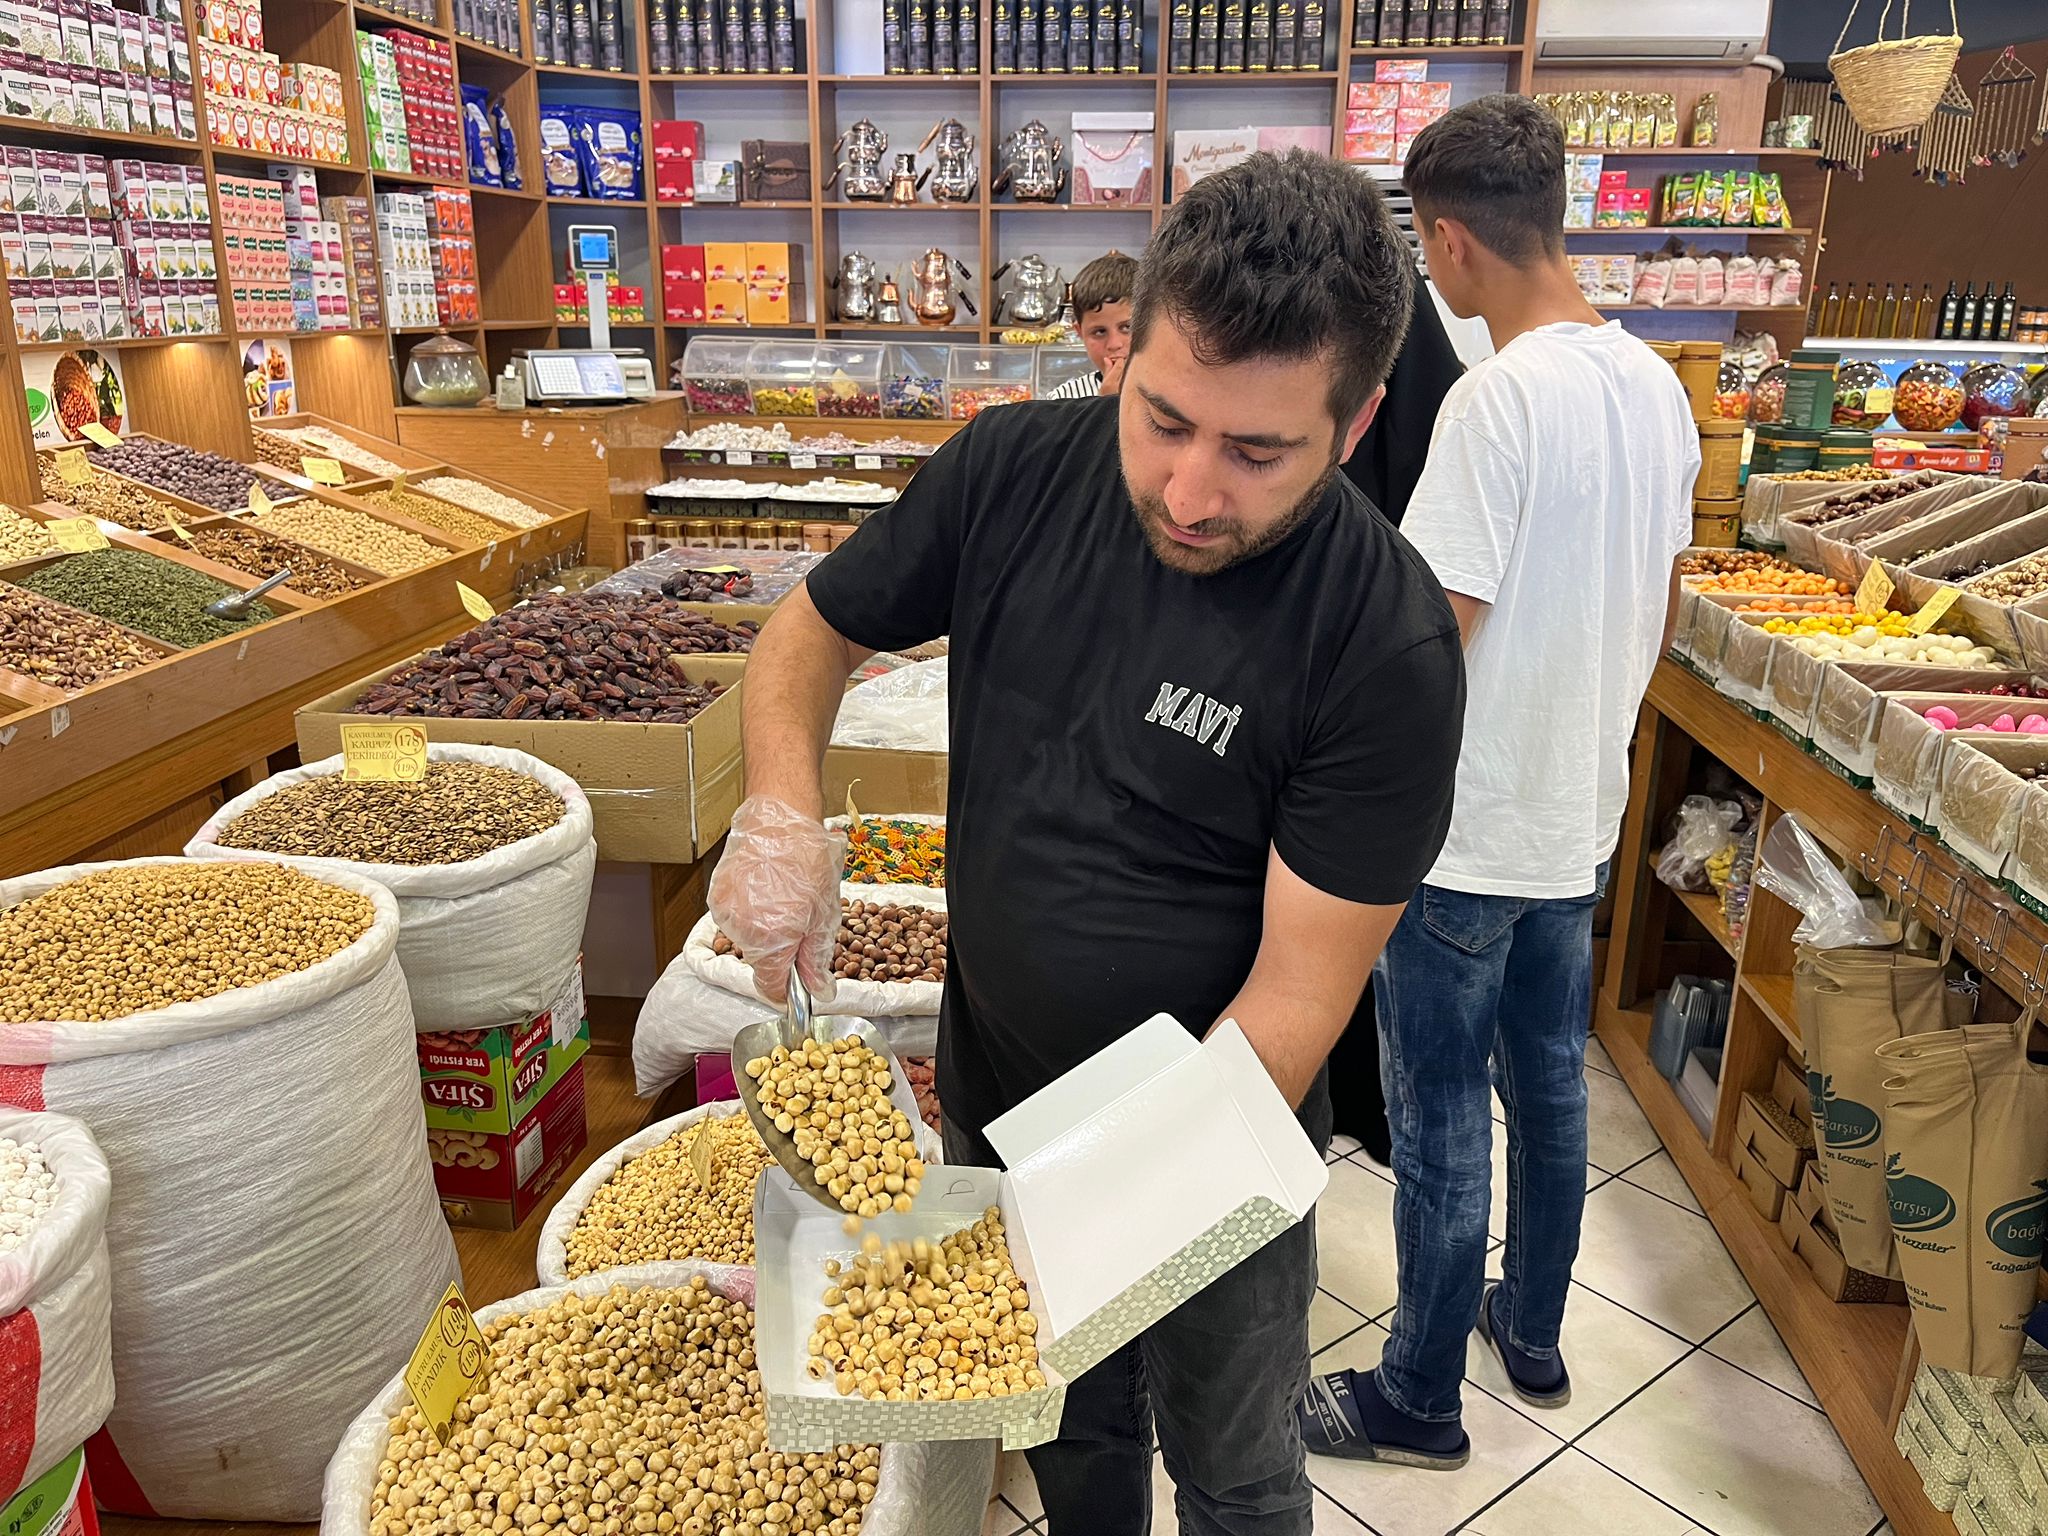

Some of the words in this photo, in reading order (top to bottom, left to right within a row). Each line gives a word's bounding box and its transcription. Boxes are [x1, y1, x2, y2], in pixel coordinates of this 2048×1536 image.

[352, 740, 392, 749] KARPUZ
[429, 1055, 463, 1066] FISTIĞI
[466, 1057, 485, 1068] YER
[429, 1083, 485, 1108] ŞİFA
[420, 1349, 447, 1400] FINDIK
[1318, 1401, 1329, 1417] JUST
